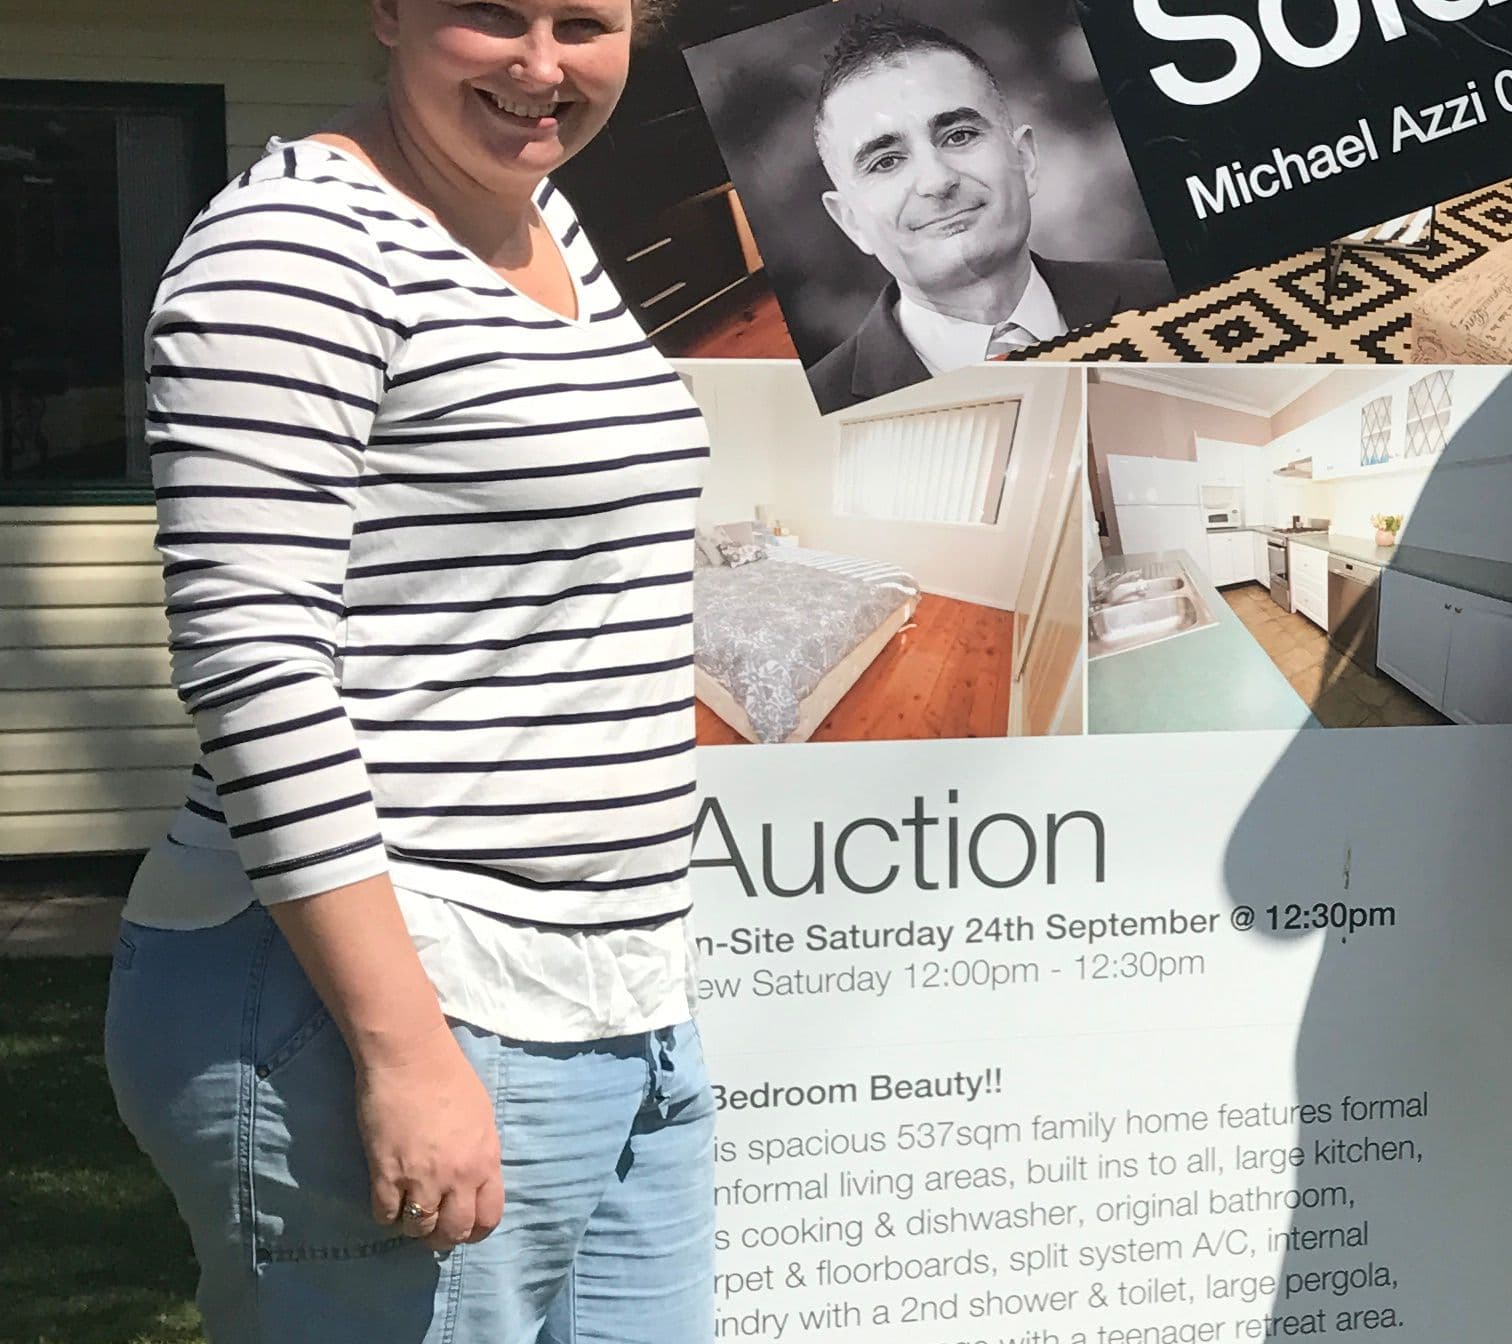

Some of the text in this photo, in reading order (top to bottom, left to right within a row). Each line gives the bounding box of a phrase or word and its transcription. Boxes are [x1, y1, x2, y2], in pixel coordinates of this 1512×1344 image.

[1185, 118, 1378, 220] Michael
[1391, 81, 1487, 153] Azzi
[689, 789, 1105, 898] Auction
[806, 920, 954, 953] Saturday
[966, 915, 1034, 944] 24th
[1045, 909, 1221, 945] September
[1231, 905, 1256, 932] @
[1266, 902, 1396, 934] 12:30pm
[752, 965, 893, 997] Saturday
[904, 957, 1040, 990] 12:00pm
[1075, 951, 1205, 983] 12:30pm
[870, 1067, 1002, 1102] Beauty!!
[748, 1129, 885, 1165] spacious
[897, 1121, 1021, 1150] 537sqm
[1032, 1112, 1116, 1143] family
[1127, 1110, 1208, 1135] home
[1218, 1102, 1332, 1128] features
[1342, 1092, 1427, 1121] formal
[840, 1170, 913, 1199] living
[925, 1165, 1014, 1191] areas,
[1028, 1156, 1088, 1184] built
[1098, 1154, 1138, 1179] ins
[1148, 1152, 1176, 1175] to
[1187, 1147, 1224, 1175] all,
[1237, 1145, 1305, 1174] large
[1315, 1137, 1422, 1165] kitchen,
[742, 1218, 862, 1247] cooking
[875, 1213, 895, 1238] &
[906, 1202, 1084, 1236] dishwasher,
[1096, 1190, 1198, 1226] original
[1210, 1186, 1354, 1214] bathroom,
[785, 1262, 806, 1288] &
[816, 1248, 998, 1286] floorboards,
[1010, 1243, 1068, 1276] split
[1080, 1239, 1182, 1271] system
[1192, 1228, 1256, 1258] A/C,
[1268, 1221, 1367, 1251] internal
[799, 1302, 860, 1330] with
[872, 1305, 890, 1325] a
[901, 1293, 957, 1322] 2nd
[969, 1291, 1079, 1317] shower
[1088, 1283, 1108, 1308] &
[1118, 1278, 1194, 1305] toilet,
[1207, 1274, 1275, 1302] large
[1286, 1262, 1398, 1299] pergola,
[1236, 1310, 1325, 1339] retreat
[1336, 1308, 1403, 1332] area.
